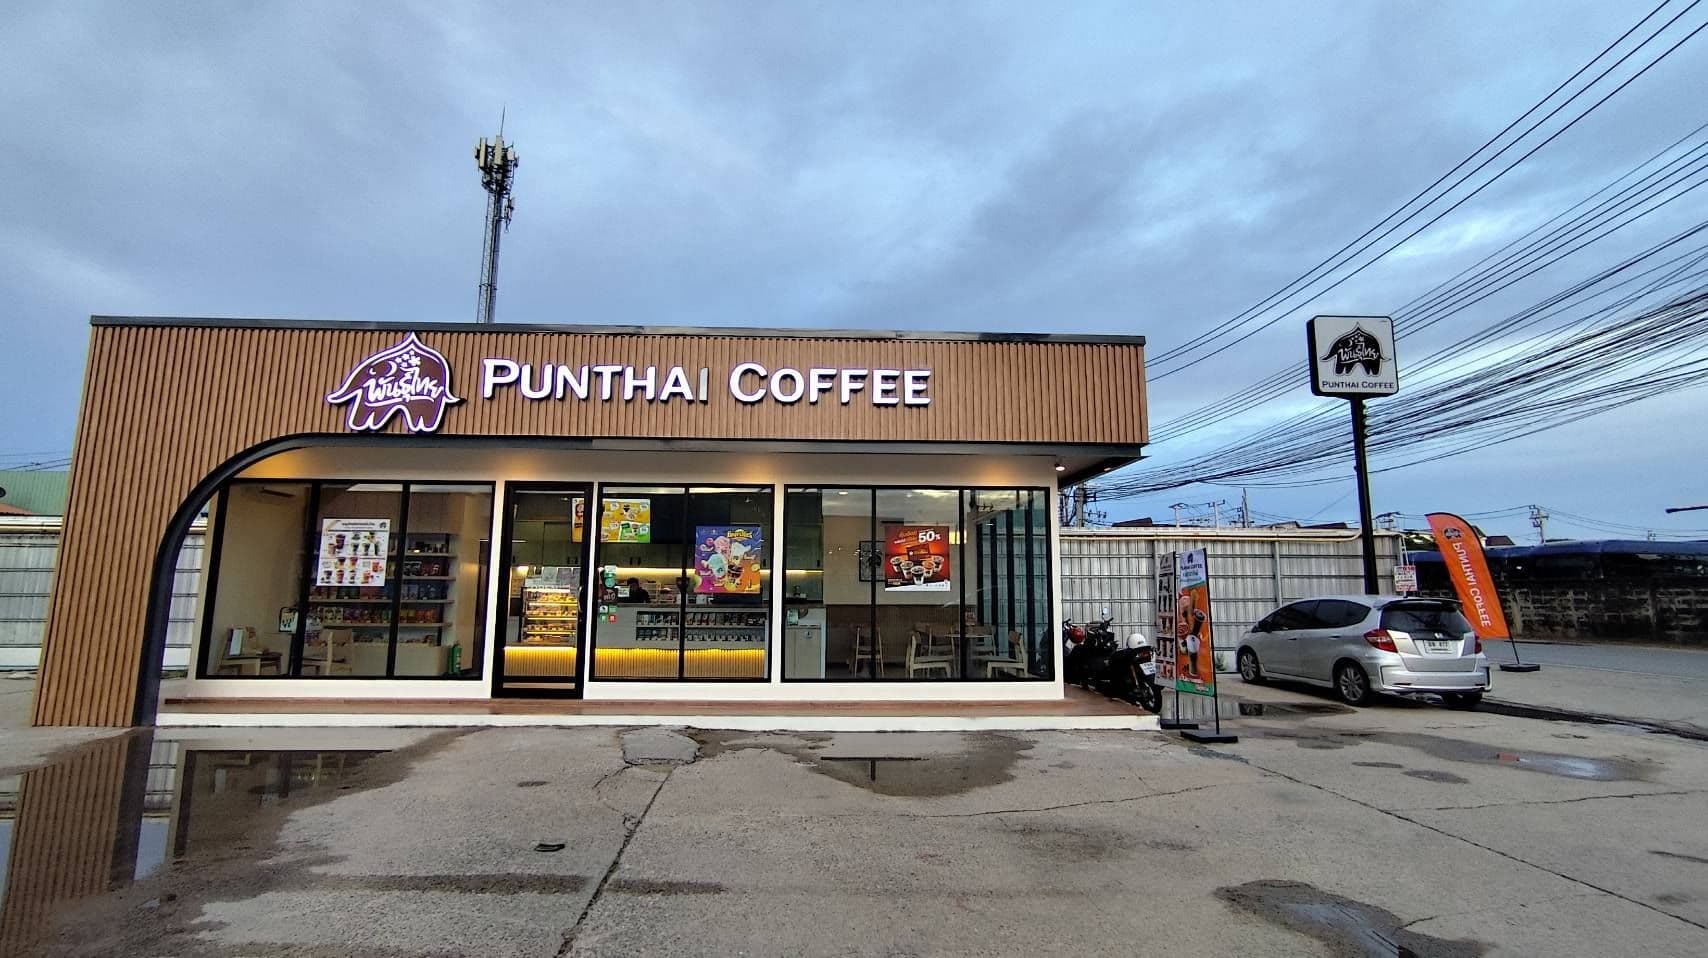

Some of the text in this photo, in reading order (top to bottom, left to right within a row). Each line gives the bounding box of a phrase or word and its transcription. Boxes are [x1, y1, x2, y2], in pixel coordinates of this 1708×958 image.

[482, 358, 932, 405] PUNTHAI COFFEE
[1322, 380, 1395, 389] PUNTHAI COFFEE
